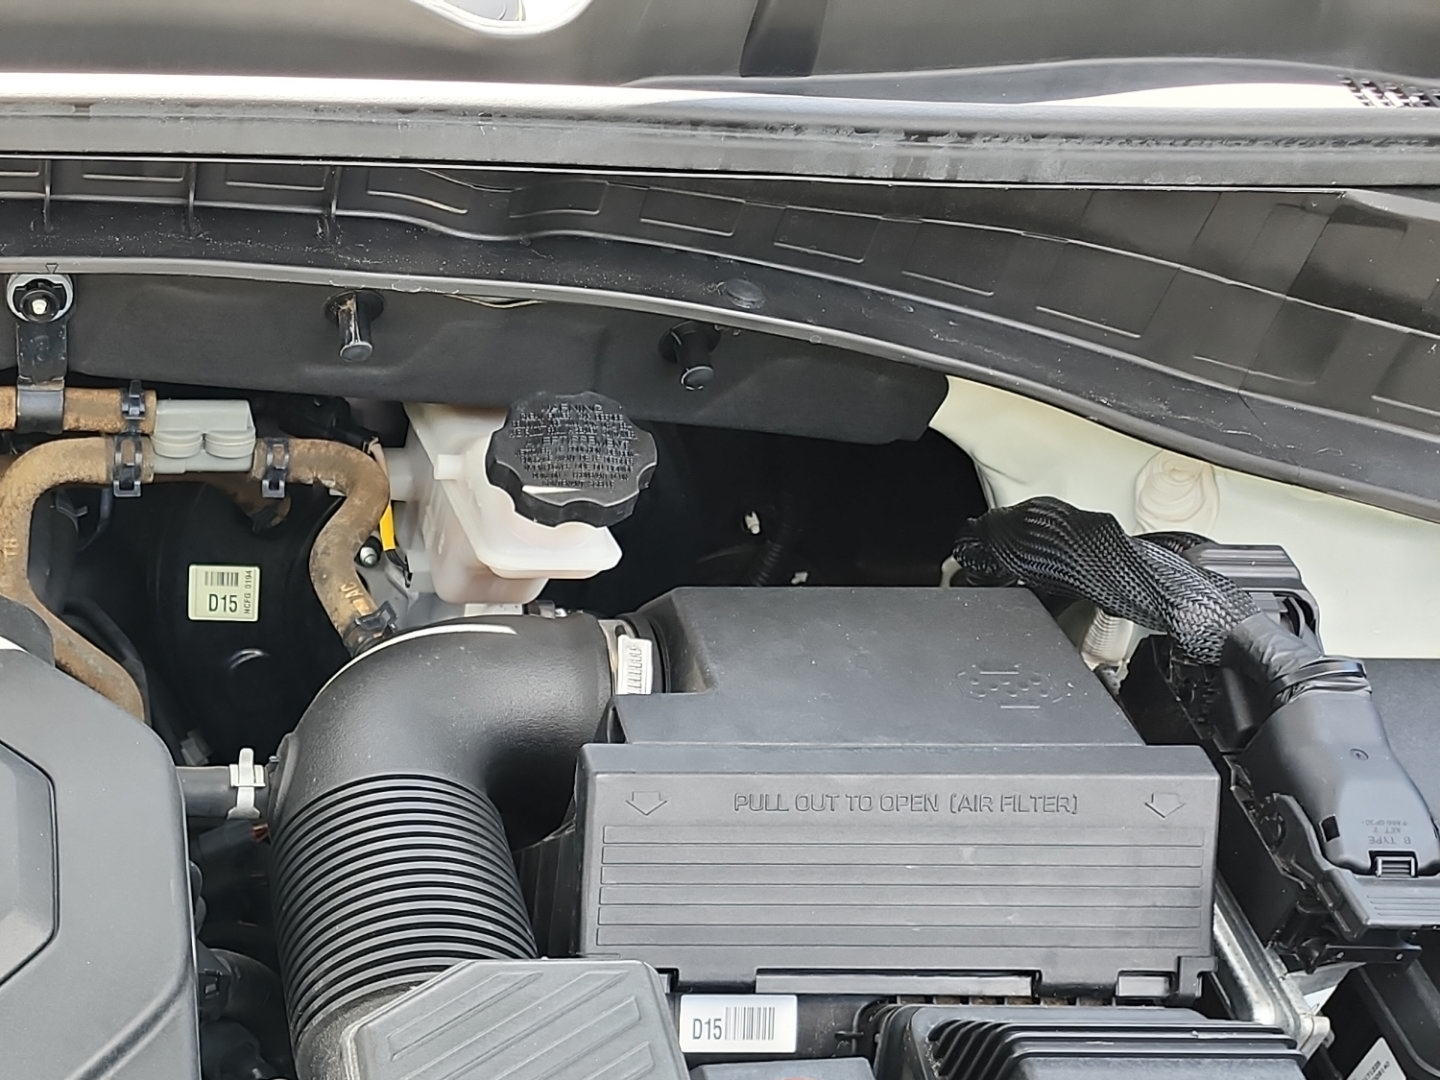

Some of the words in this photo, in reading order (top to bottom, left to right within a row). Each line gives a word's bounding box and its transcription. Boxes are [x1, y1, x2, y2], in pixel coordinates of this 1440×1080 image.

[208, 593, 238, 613] D15
[734, 792, 789, 812] PULL
[795, 792, 840, 812] OUT
[845, 792, 873, 812] TO
[879, 792, 939, 812] OPEN
[1367, 835, 1397, 845] TYPE
[692, 1018, 722, 1040] D15
